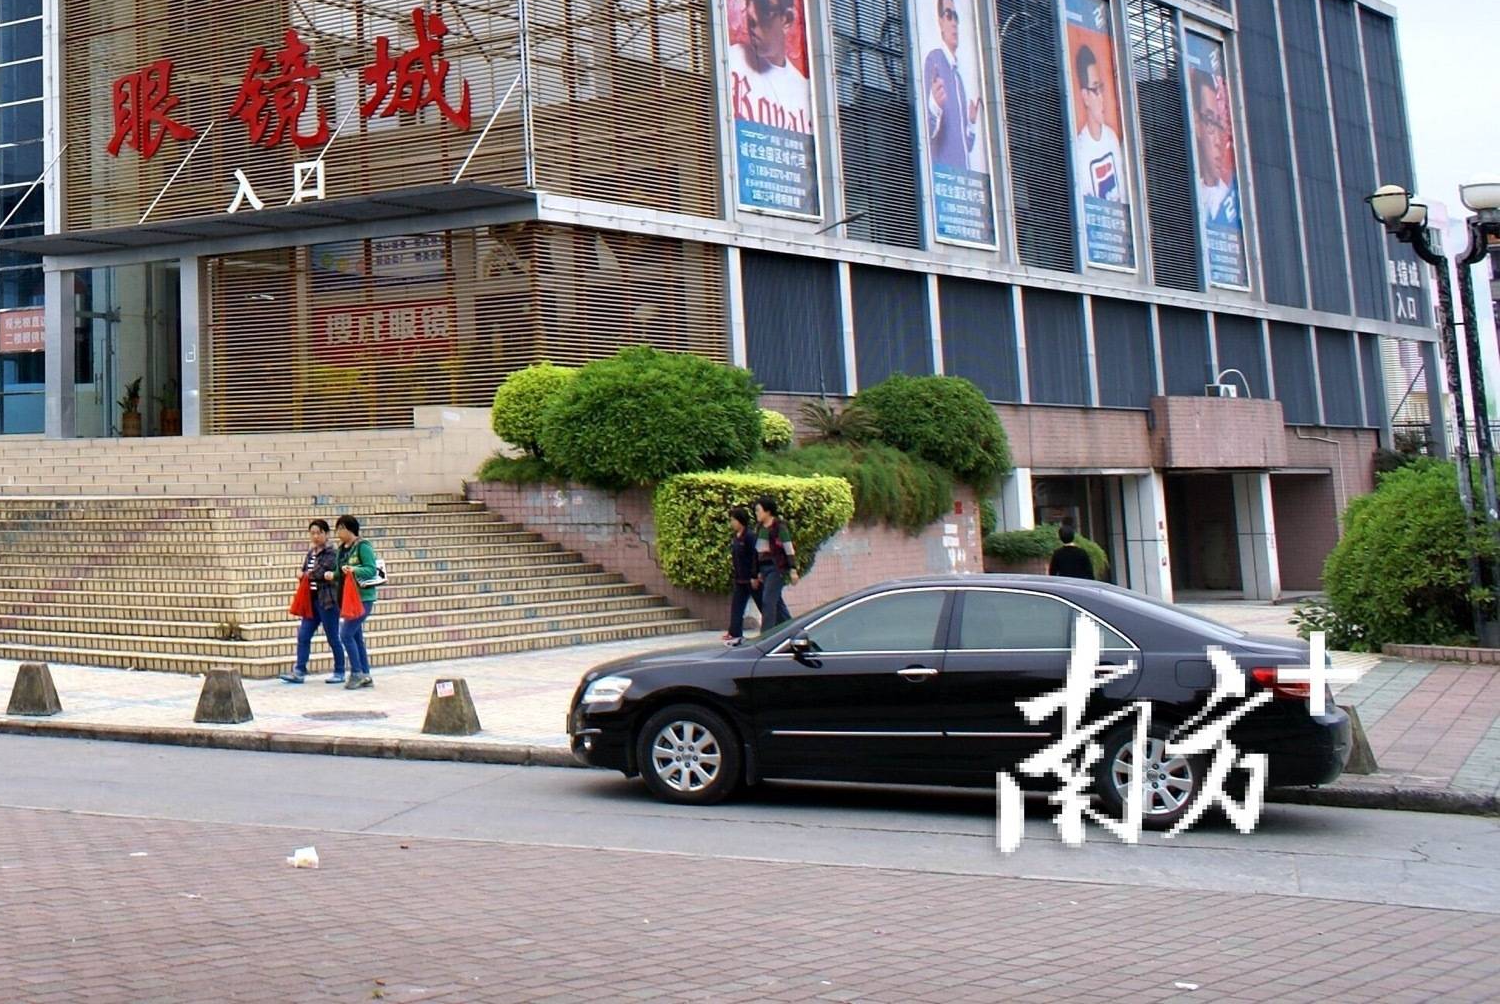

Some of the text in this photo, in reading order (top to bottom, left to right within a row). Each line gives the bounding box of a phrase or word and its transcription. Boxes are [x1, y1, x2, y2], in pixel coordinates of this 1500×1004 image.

[106, 6, 472, 160] 眼镜城
[227, 159, 325, 214] 入口
[1396, 292, 1418, 320] 入口
